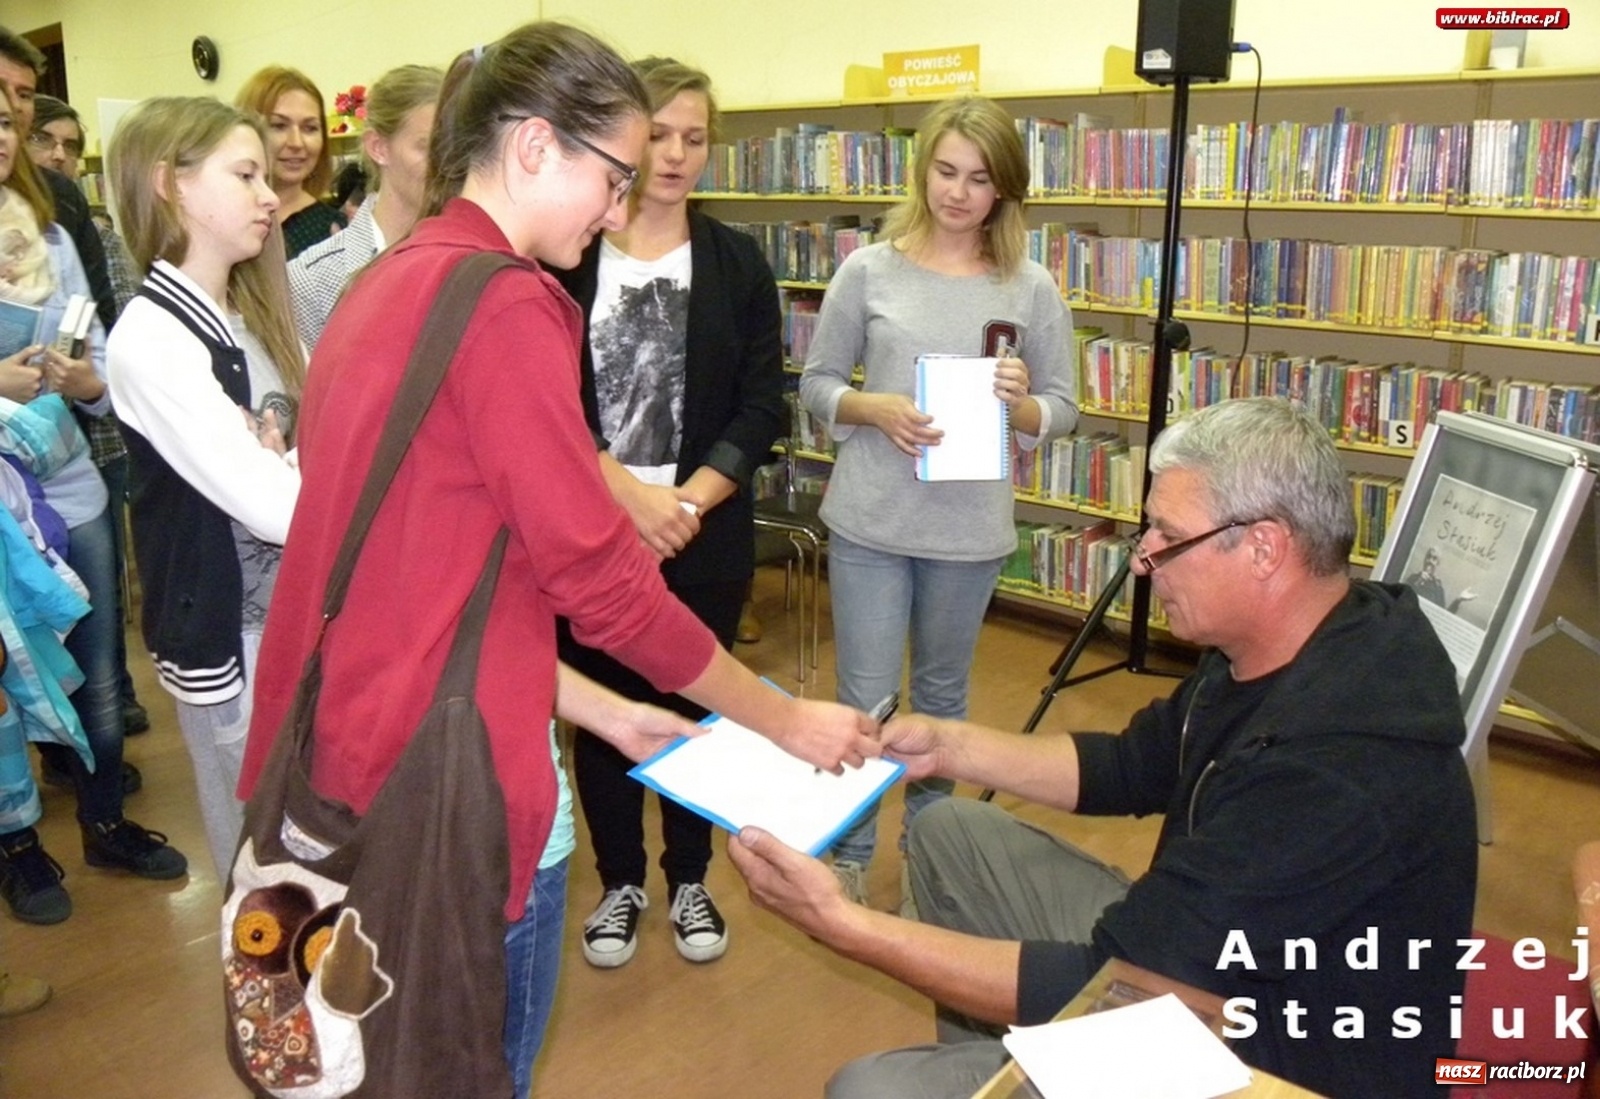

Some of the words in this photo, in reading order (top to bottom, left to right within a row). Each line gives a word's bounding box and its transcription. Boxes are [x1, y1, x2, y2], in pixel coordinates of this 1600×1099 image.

[903, 54, 962, 71] POWIEŚĆ
[888, 71, 976, 88] OBYCZAJOWA
[1395, 424, 1408, 445] S
[1442, 489, 1511, 540] Andrzej
[1436, 520, 1497, 562] Stasiuk
